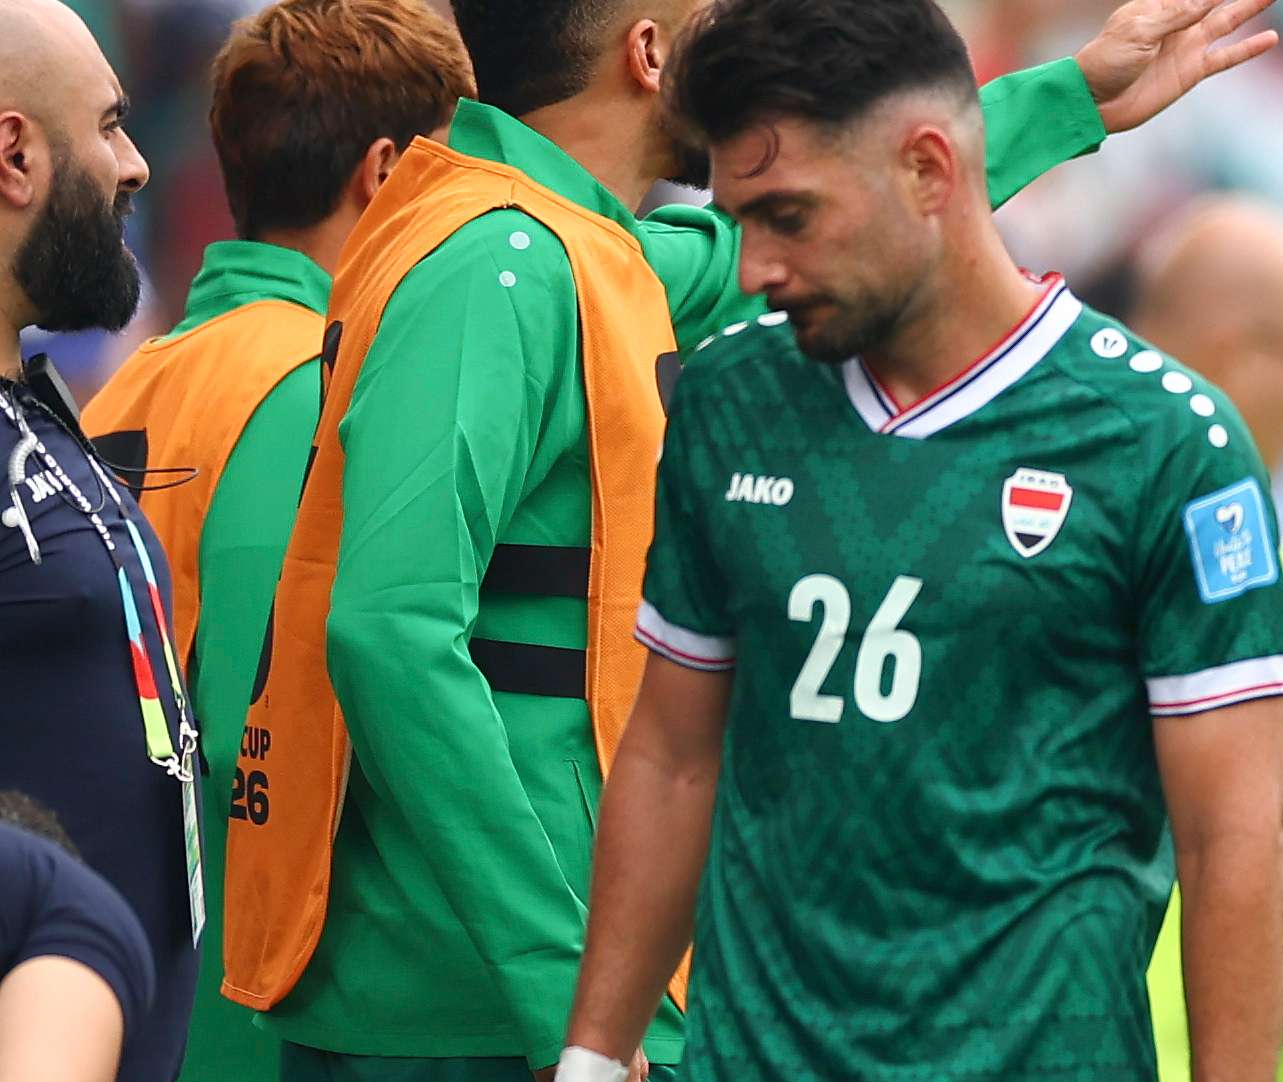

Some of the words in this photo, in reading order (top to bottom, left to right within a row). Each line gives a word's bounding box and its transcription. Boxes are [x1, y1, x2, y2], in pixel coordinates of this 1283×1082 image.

[725, 472, 794, 506] JAKO
[788, 573, 923, 723] 26
[240, 725, 271, 760] CUP
[230, 766, 269, 826] 26
